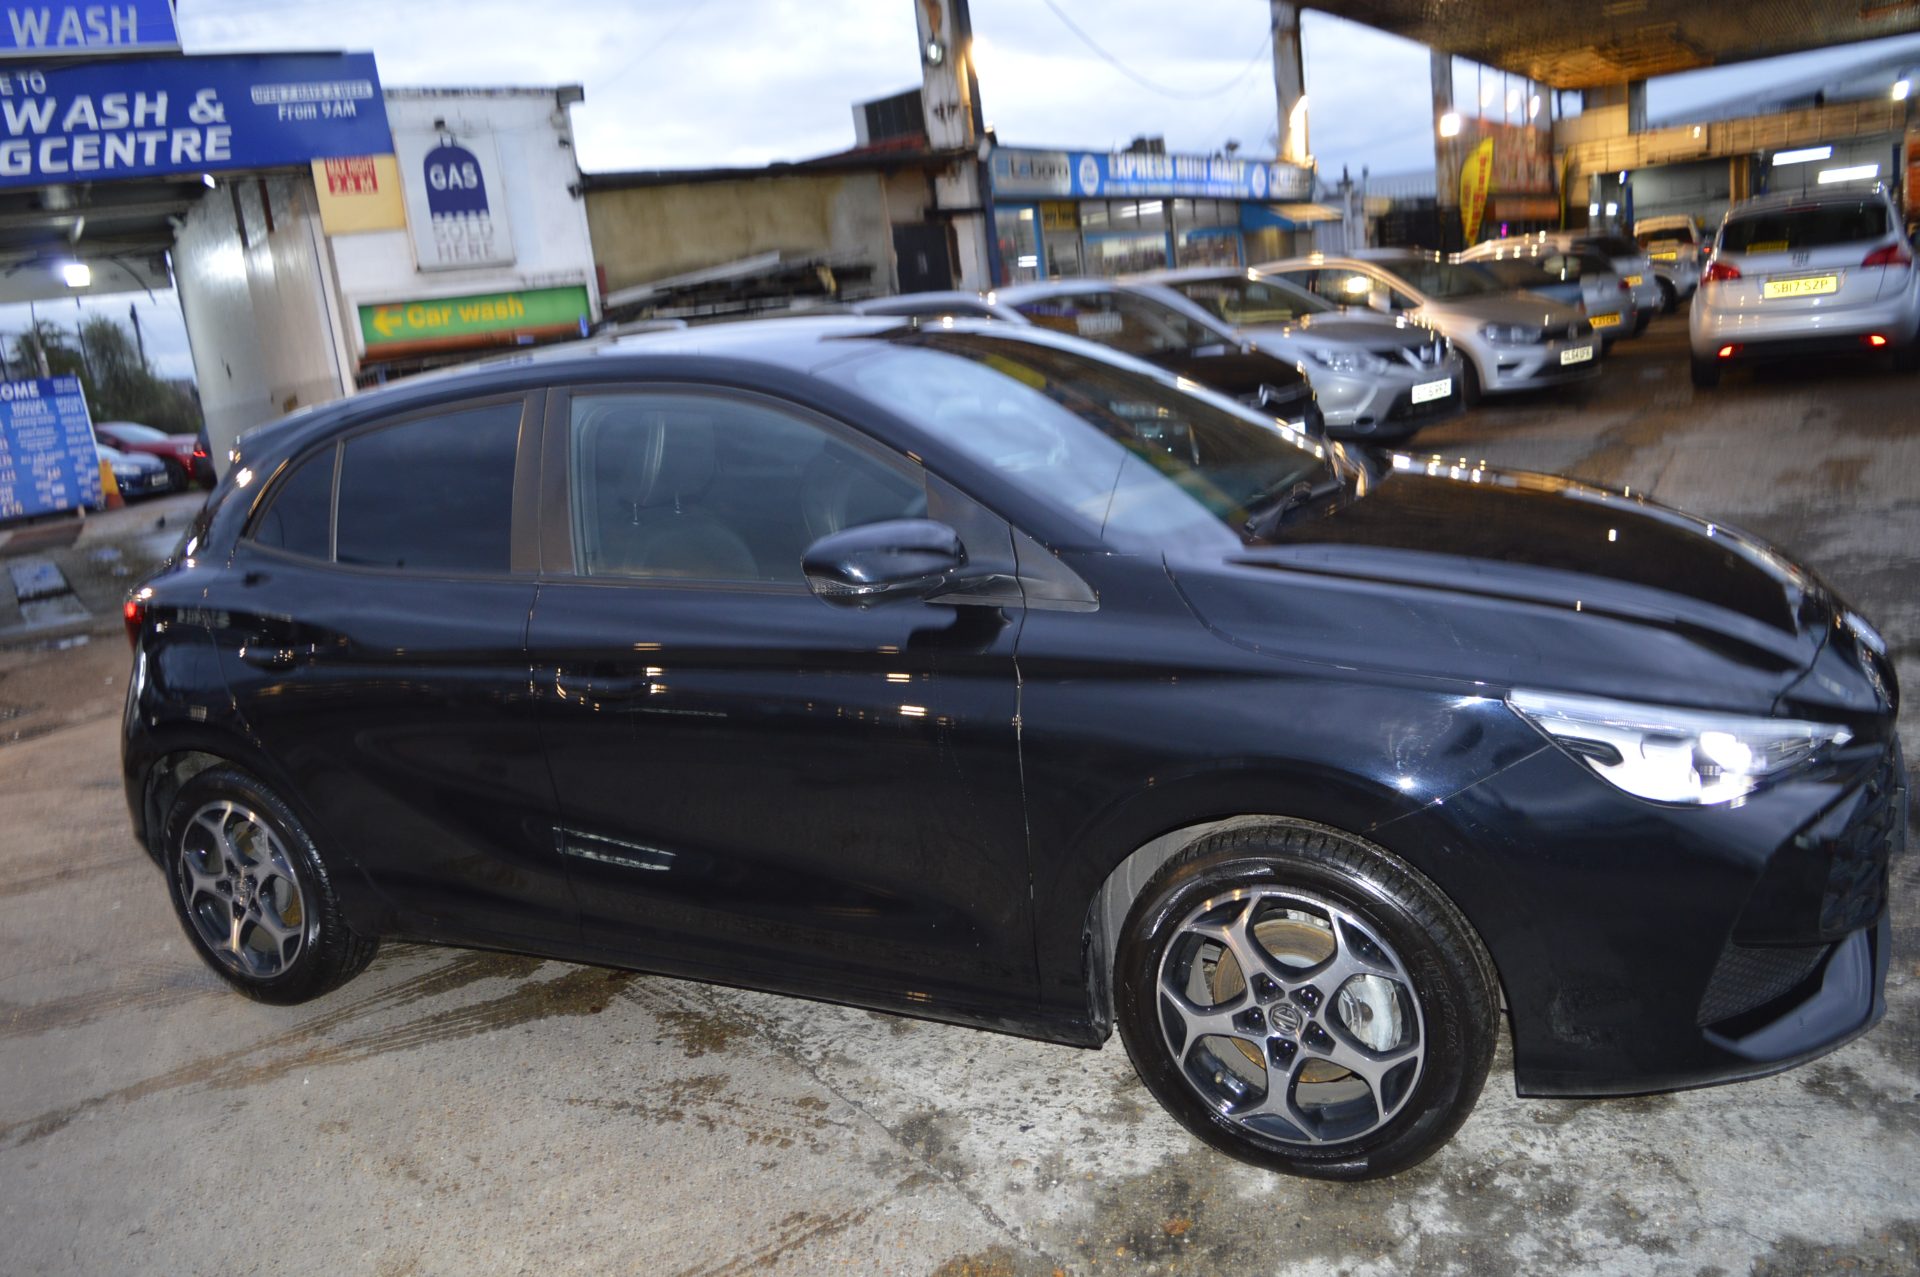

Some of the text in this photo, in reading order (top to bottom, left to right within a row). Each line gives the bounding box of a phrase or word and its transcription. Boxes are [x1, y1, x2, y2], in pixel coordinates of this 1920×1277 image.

[8, 4, 138, 47] WASH
[20, 70, 46, 94] TO
[2, 88, 226, 135] WASH &
[430, 161, 478, 190] GAS
[407, 296, 524, 328] Car wash
